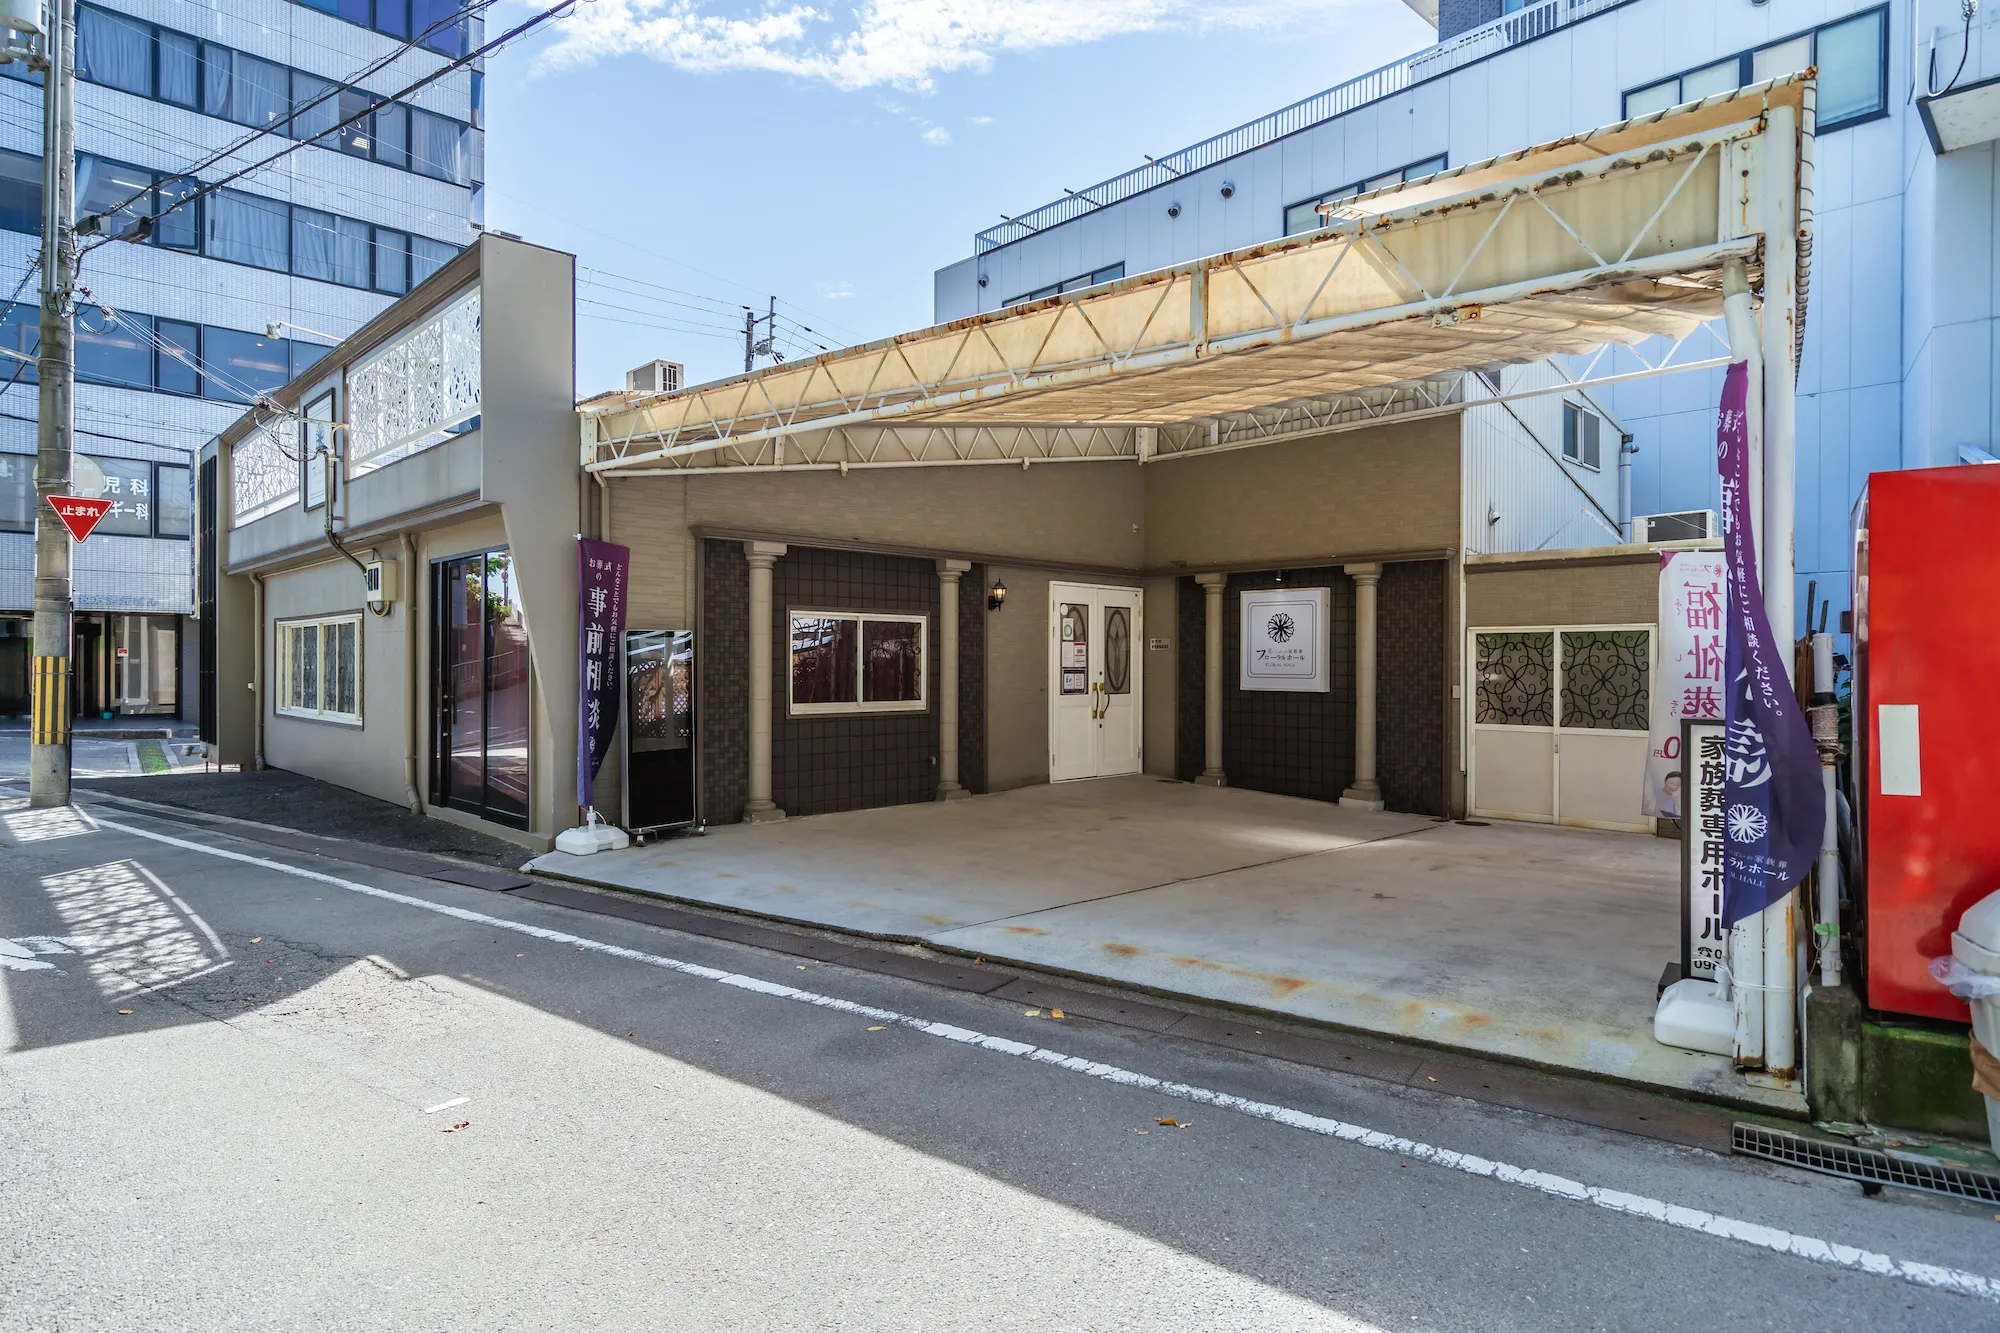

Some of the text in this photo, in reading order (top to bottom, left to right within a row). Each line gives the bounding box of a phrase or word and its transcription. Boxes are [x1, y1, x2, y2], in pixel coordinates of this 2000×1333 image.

[61, 504, 101, 518] 止まれ
[588, 557, 613, 572] お葬式
[595, 572, 603, 582] の
[1256, 649, 1306, 661] フローラルホール
[1729, 857, 1791, 882] ラルホール
[1738, 874, 1766, 888] HALL
